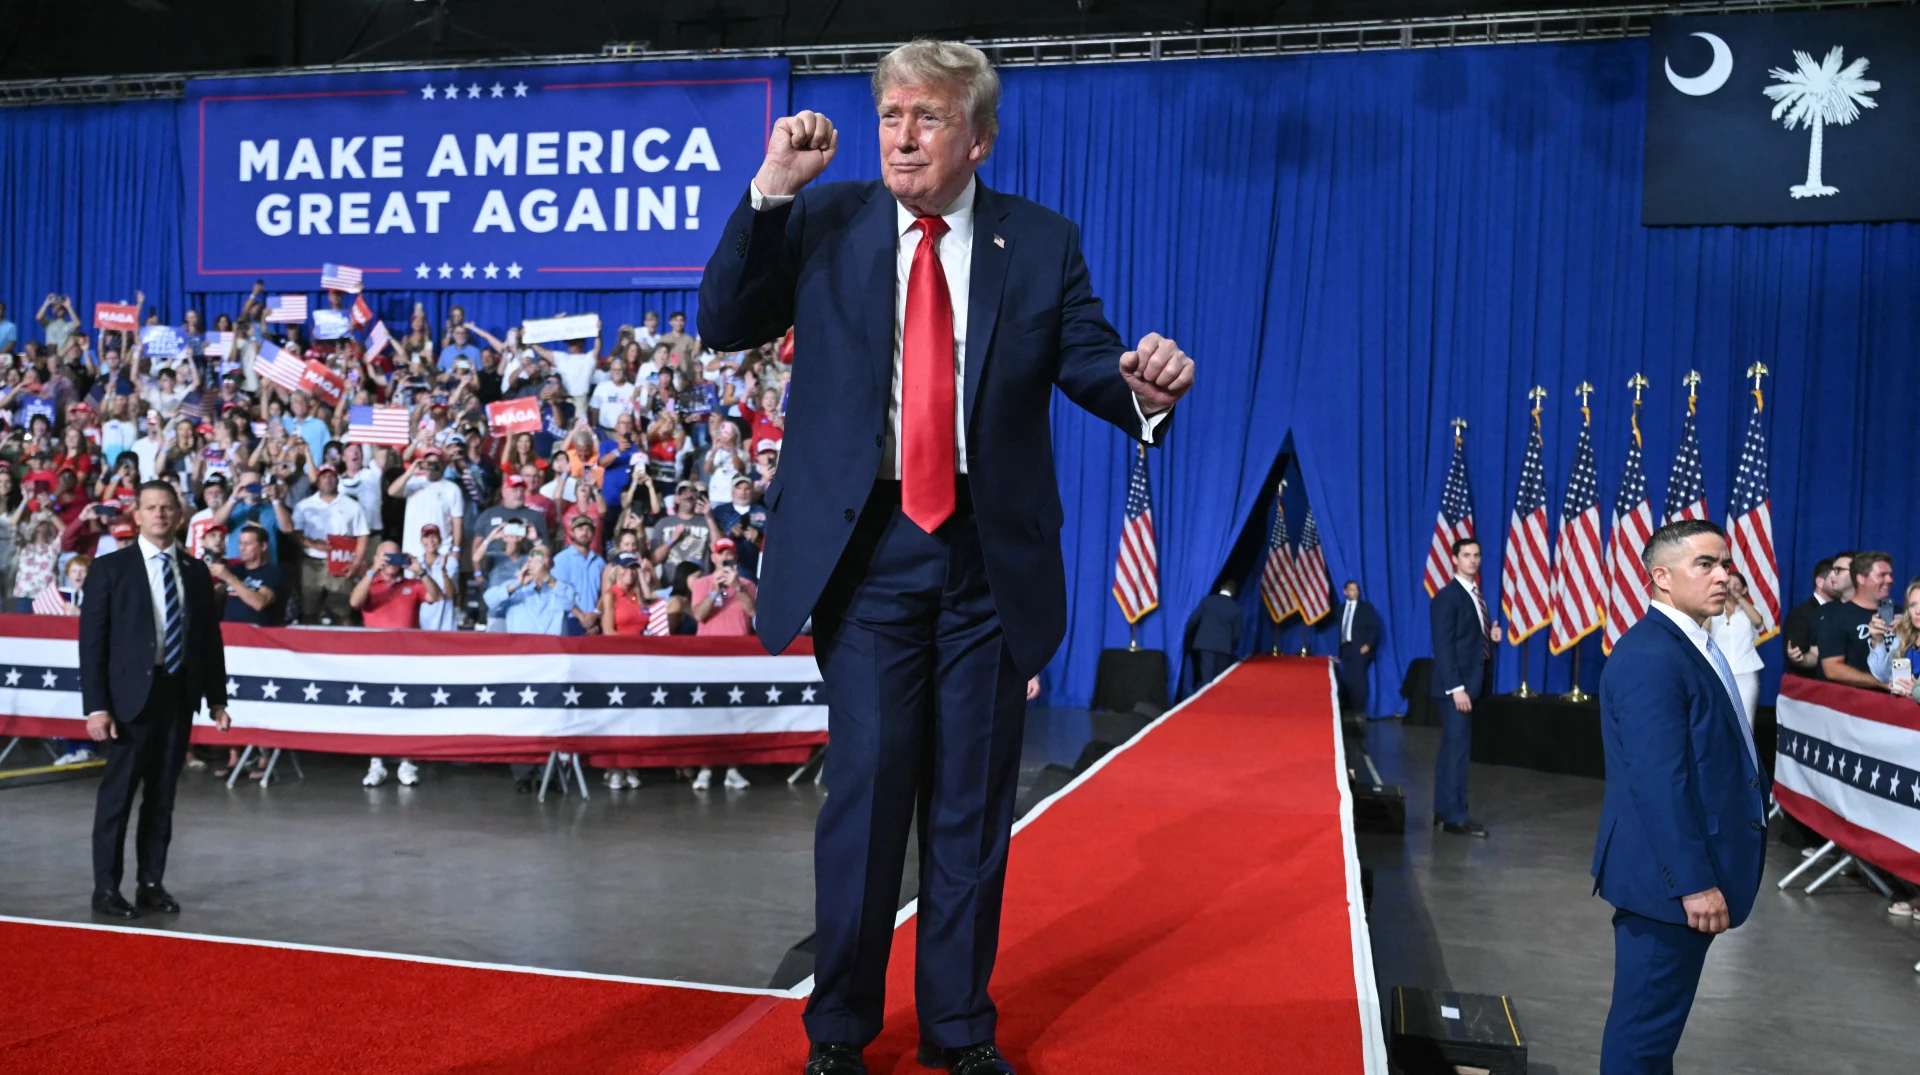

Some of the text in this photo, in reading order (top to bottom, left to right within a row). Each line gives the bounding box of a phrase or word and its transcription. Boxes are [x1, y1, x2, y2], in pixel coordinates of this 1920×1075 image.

[239, 127, 721, 182] MAKE AMERICA
[256, 185, 701, 237] GREAT AGAIN!
[98, 311, 134, 323] MAGA
[305, 369, 341, 399] MAGA
[495, 409, 537, 425] MAGA
[662, 525, 709, 537] TMP
